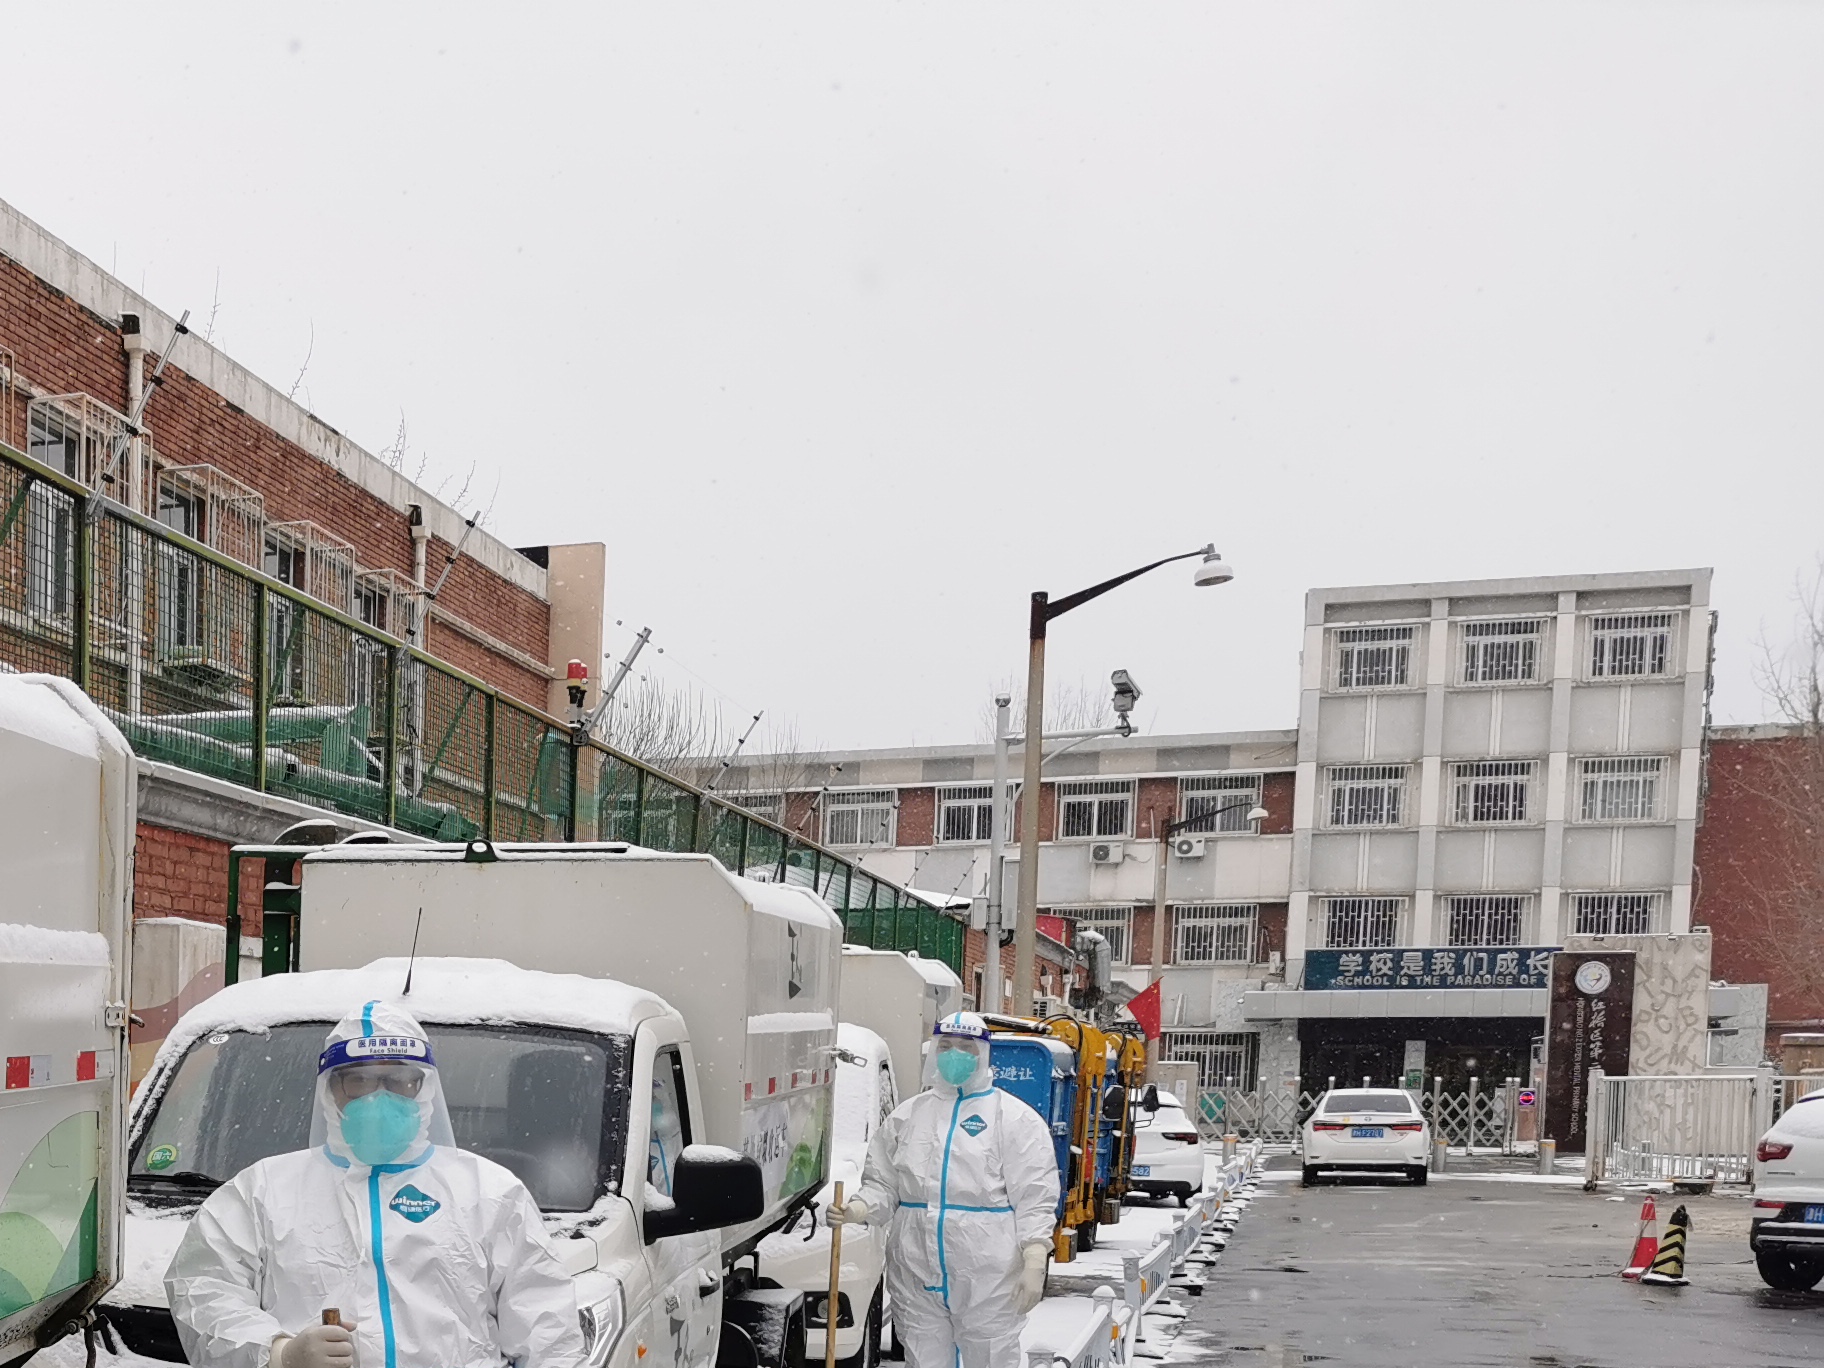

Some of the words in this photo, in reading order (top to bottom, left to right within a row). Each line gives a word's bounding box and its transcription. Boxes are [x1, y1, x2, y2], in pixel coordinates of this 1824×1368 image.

[1338, 951, 1549, 976] 学校是我们成长
[1336, 975, 1390, 986] SCHOOL
[1396, 975, 1409, 986] IS
[1415, 975, 1440, 986] THE
[1447, 975, 1513, 985] PARADISE
[1519, 974, 1538, 985] OF
